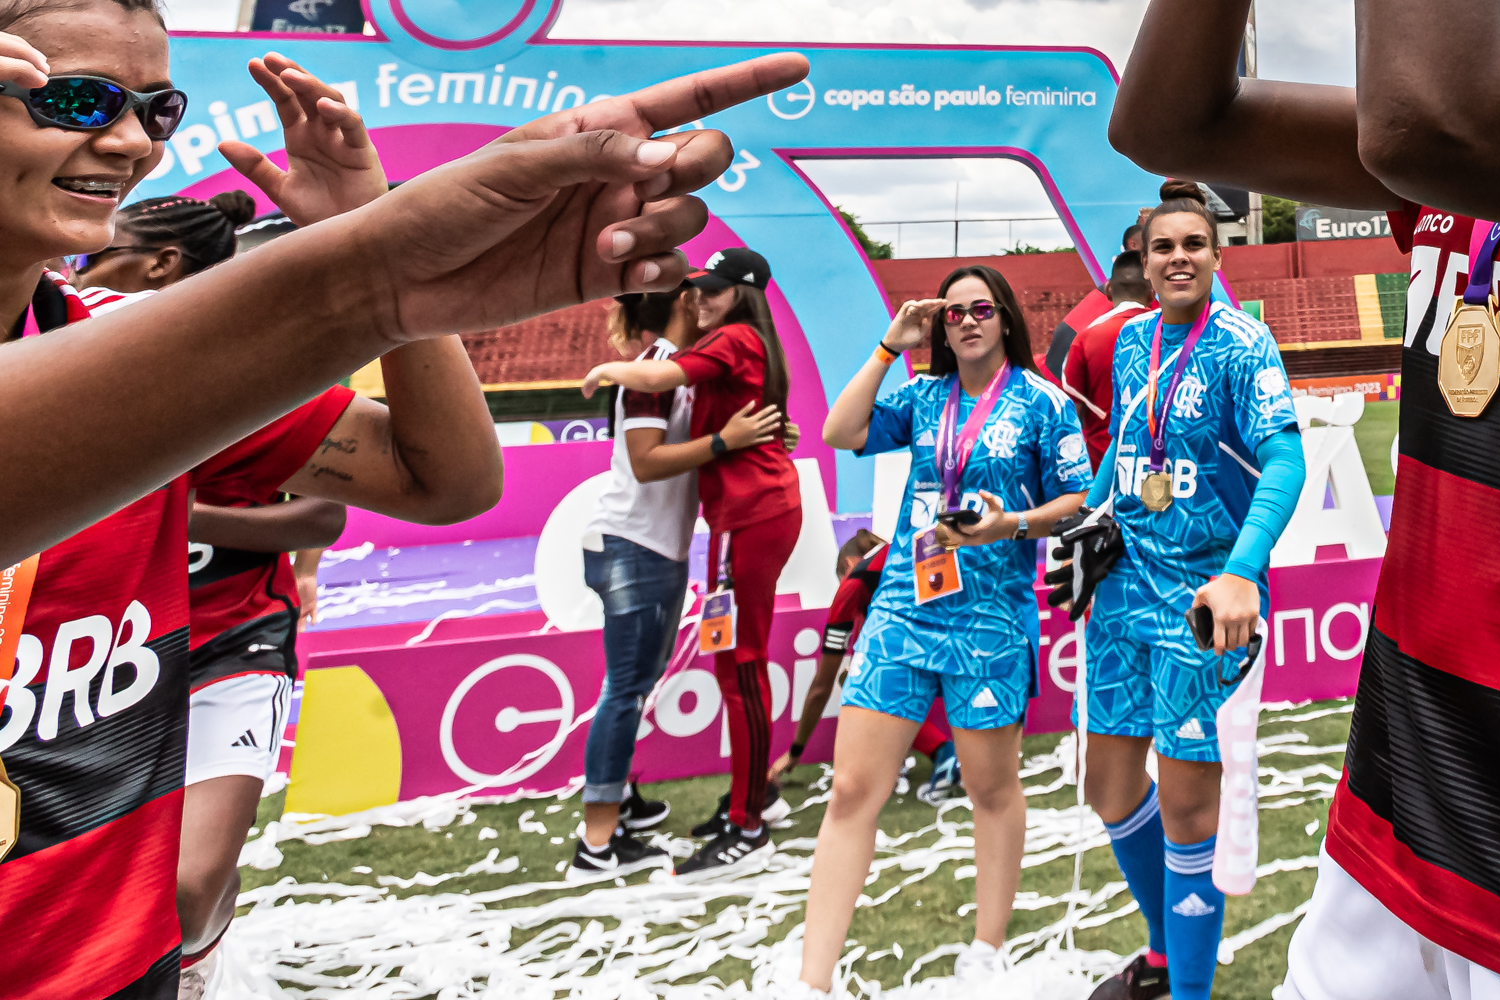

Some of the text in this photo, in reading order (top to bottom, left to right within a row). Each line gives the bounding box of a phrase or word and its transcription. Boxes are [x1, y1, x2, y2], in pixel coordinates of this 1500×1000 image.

[824, 83, 1097, 111] copa são paulo feminina
